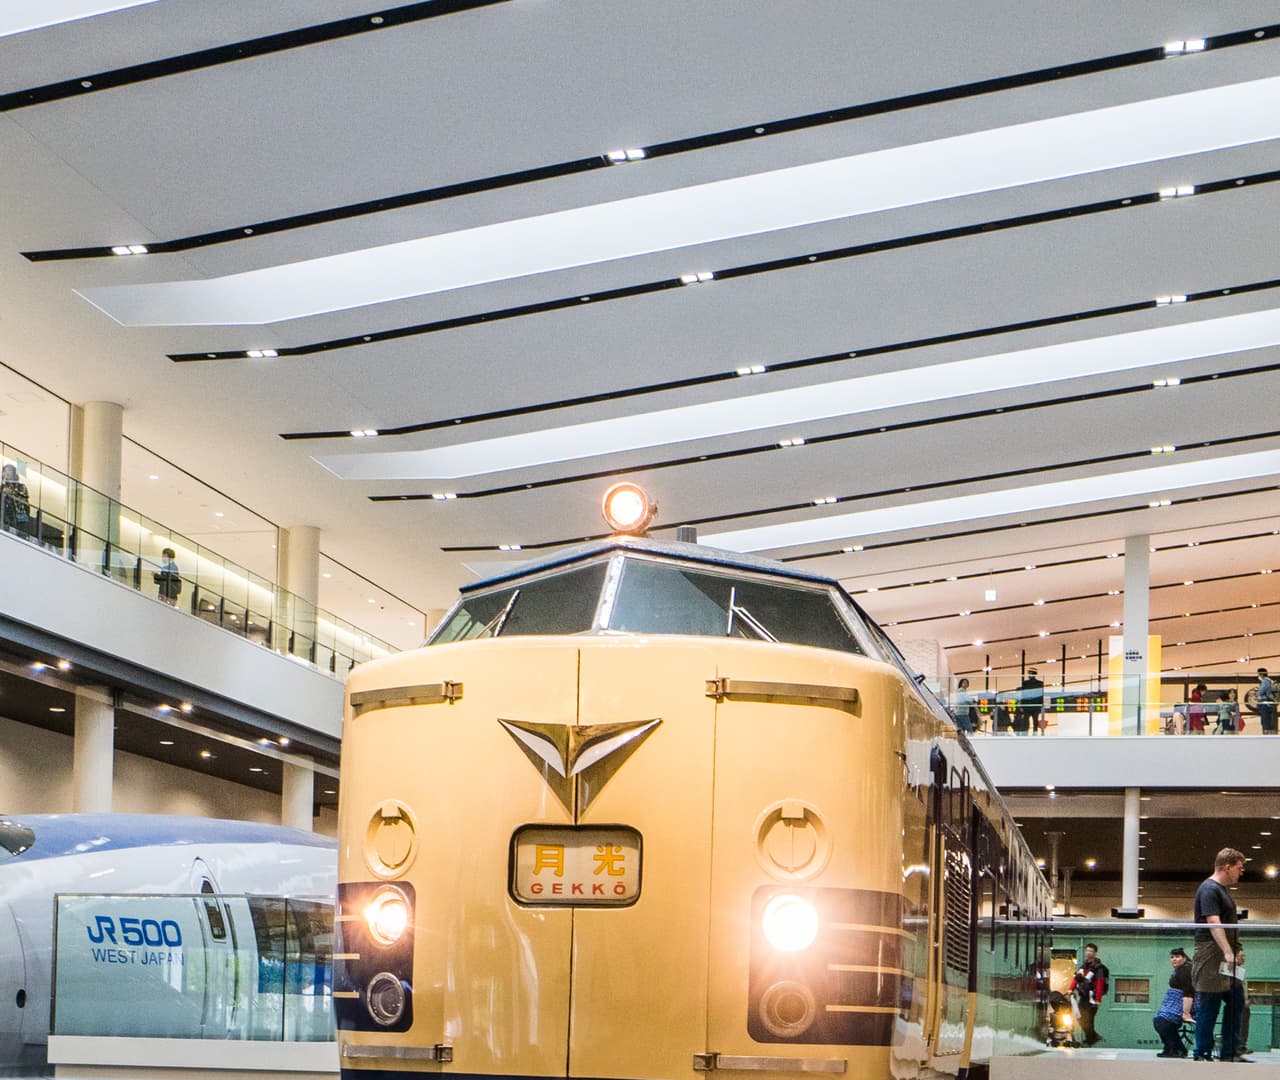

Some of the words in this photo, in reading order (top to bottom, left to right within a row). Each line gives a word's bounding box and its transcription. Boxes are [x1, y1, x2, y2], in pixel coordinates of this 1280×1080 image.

[532, 843, 625, 877] 月光
[86, 915, 118, 944] JR
[119, 917, 183, 947] 500
[91, 948, 136, 964] WEST
